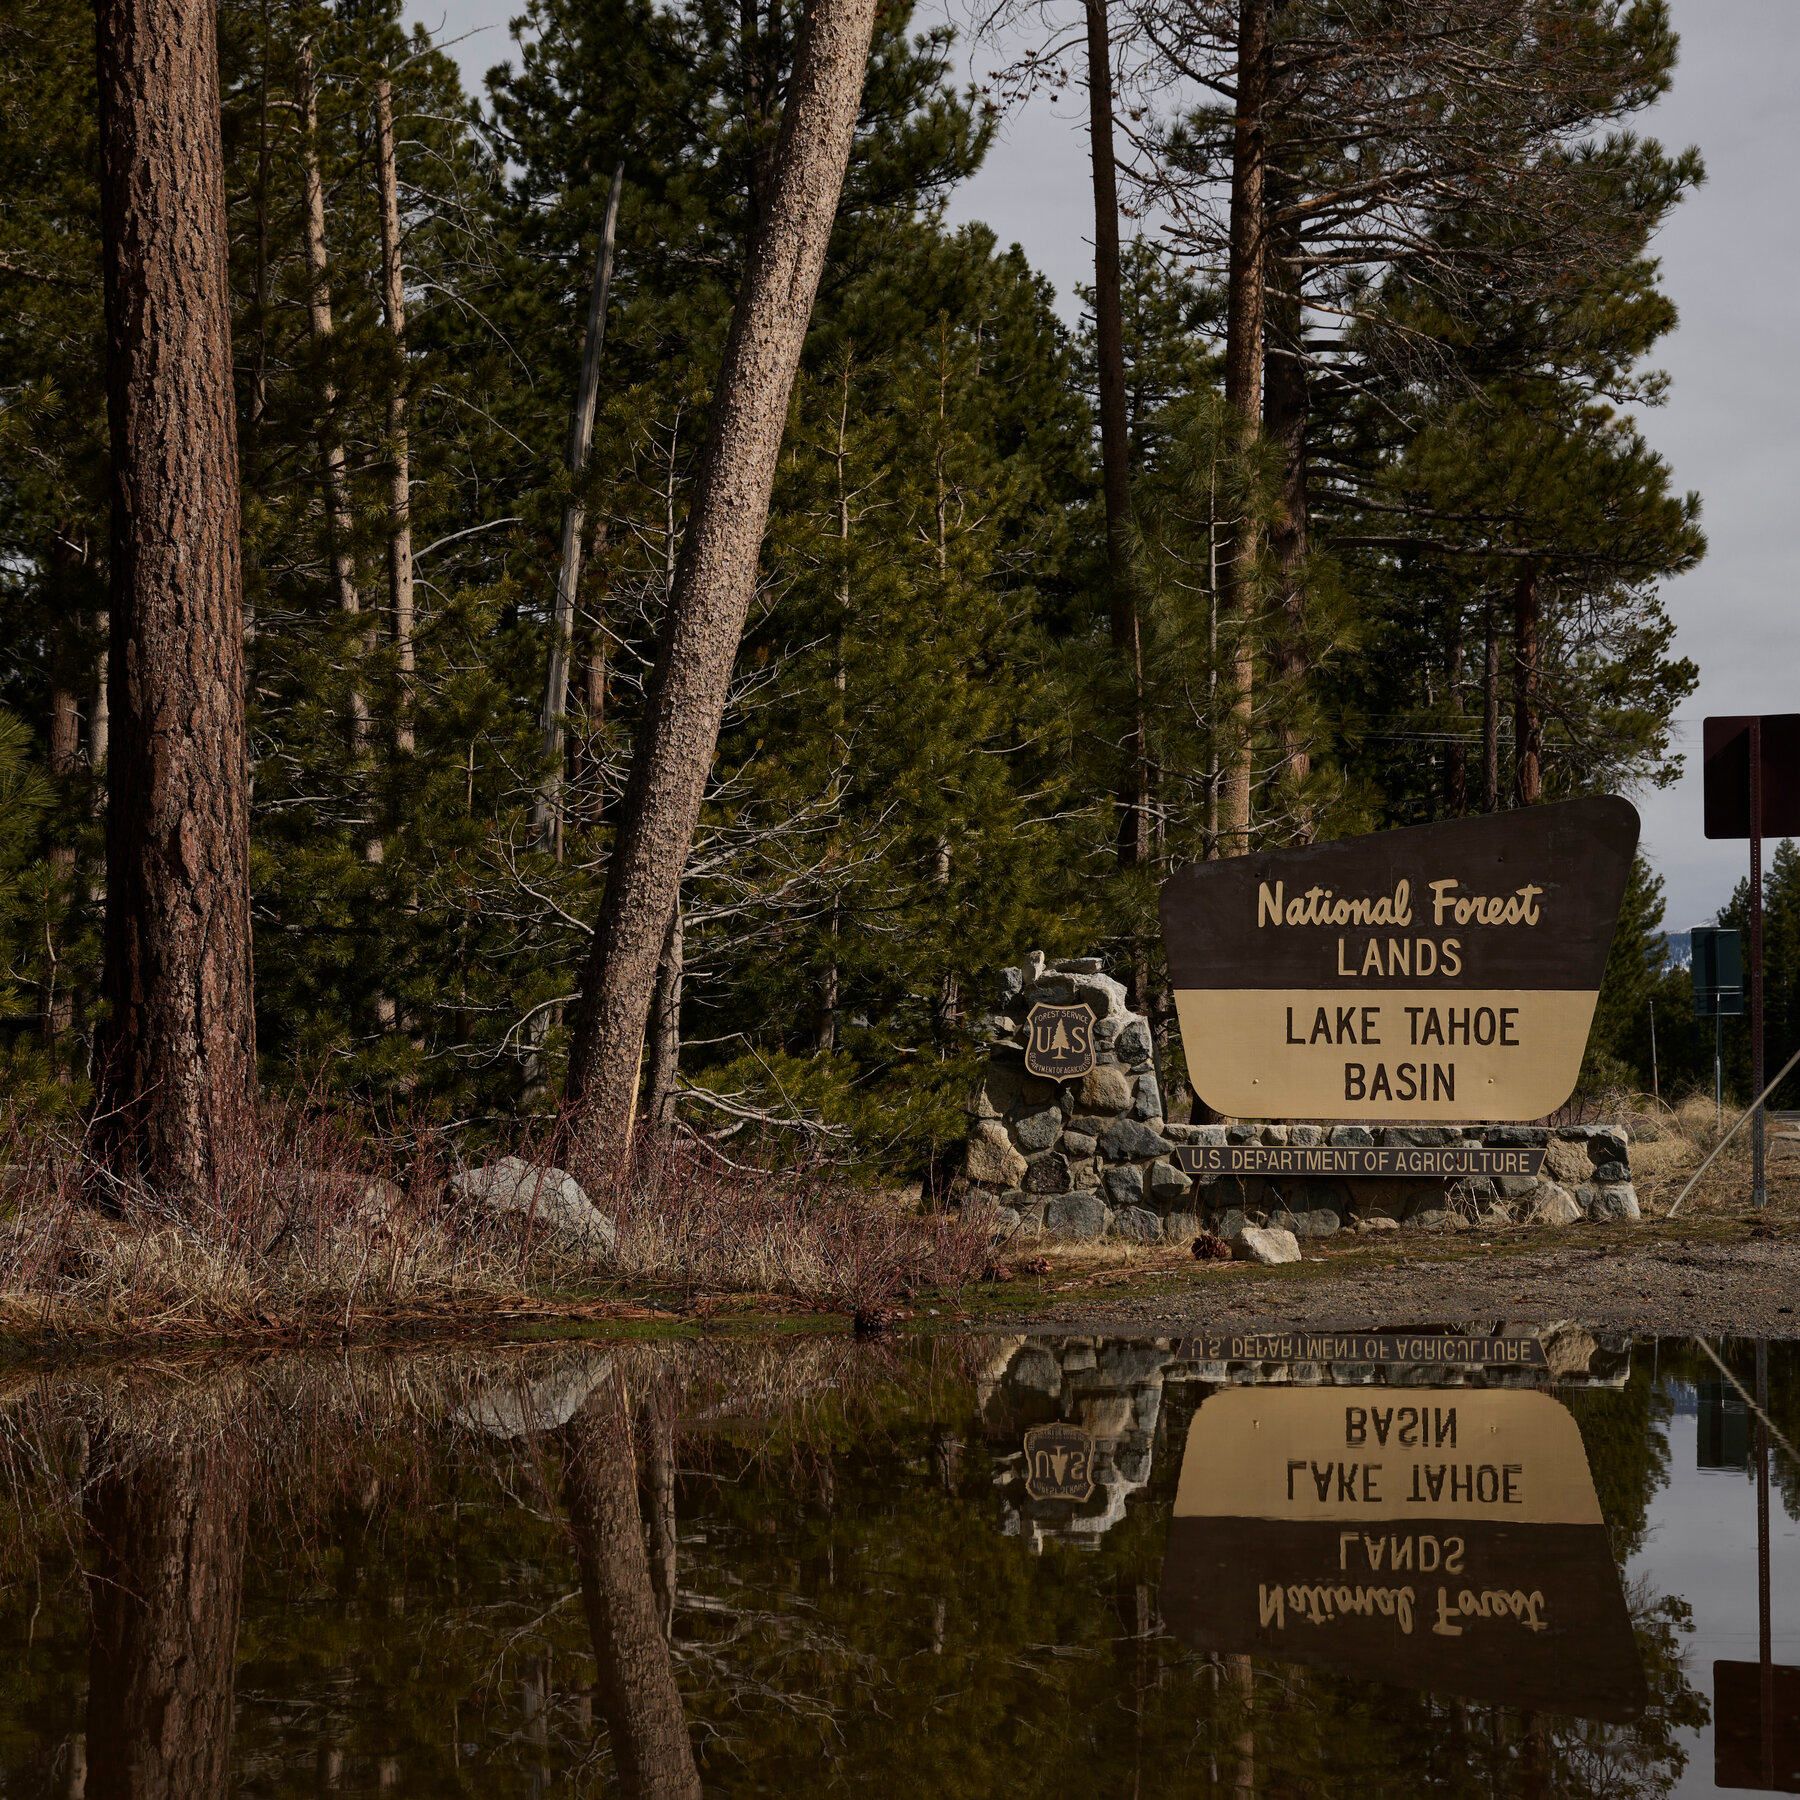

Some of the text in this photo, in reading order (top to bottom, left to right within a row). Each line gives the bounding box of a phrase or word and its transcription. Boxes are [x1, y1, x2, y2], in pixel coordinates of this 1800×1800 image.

[1257, 878, 1543, 927] National Forest
[1337, 938, 1462, 977] LANDS
[1034, 1010, 1089, 1025] FOREST SERVICE
[1286, 1006, 1520, 1046] LAKE TAHOE
[1344, 1063, 1455, 1102] BASIN
[1191, 1149, 1530, 1173] U.S. DEPARTMENT OF AGRICULTURE
